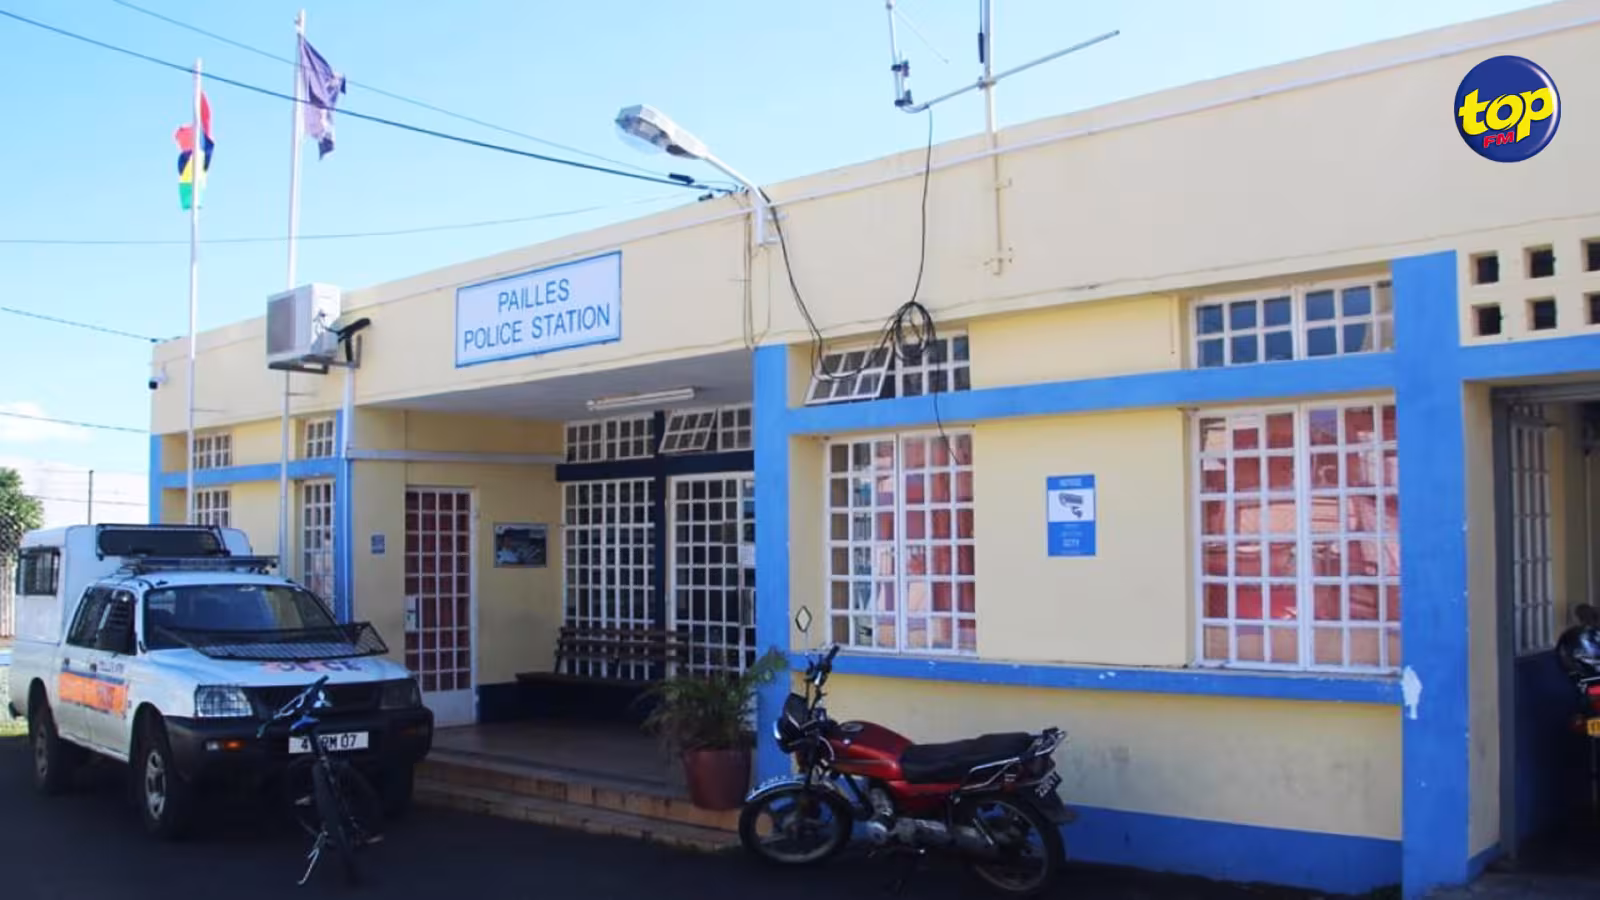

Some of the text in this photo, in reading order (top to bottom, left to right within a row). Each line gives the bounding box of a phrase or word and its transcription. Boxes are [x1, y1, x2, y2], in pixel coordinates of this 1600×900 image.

[498, 278, 570, 312] PAILLES
[464, 302, 610, 351] POLICE STATION
